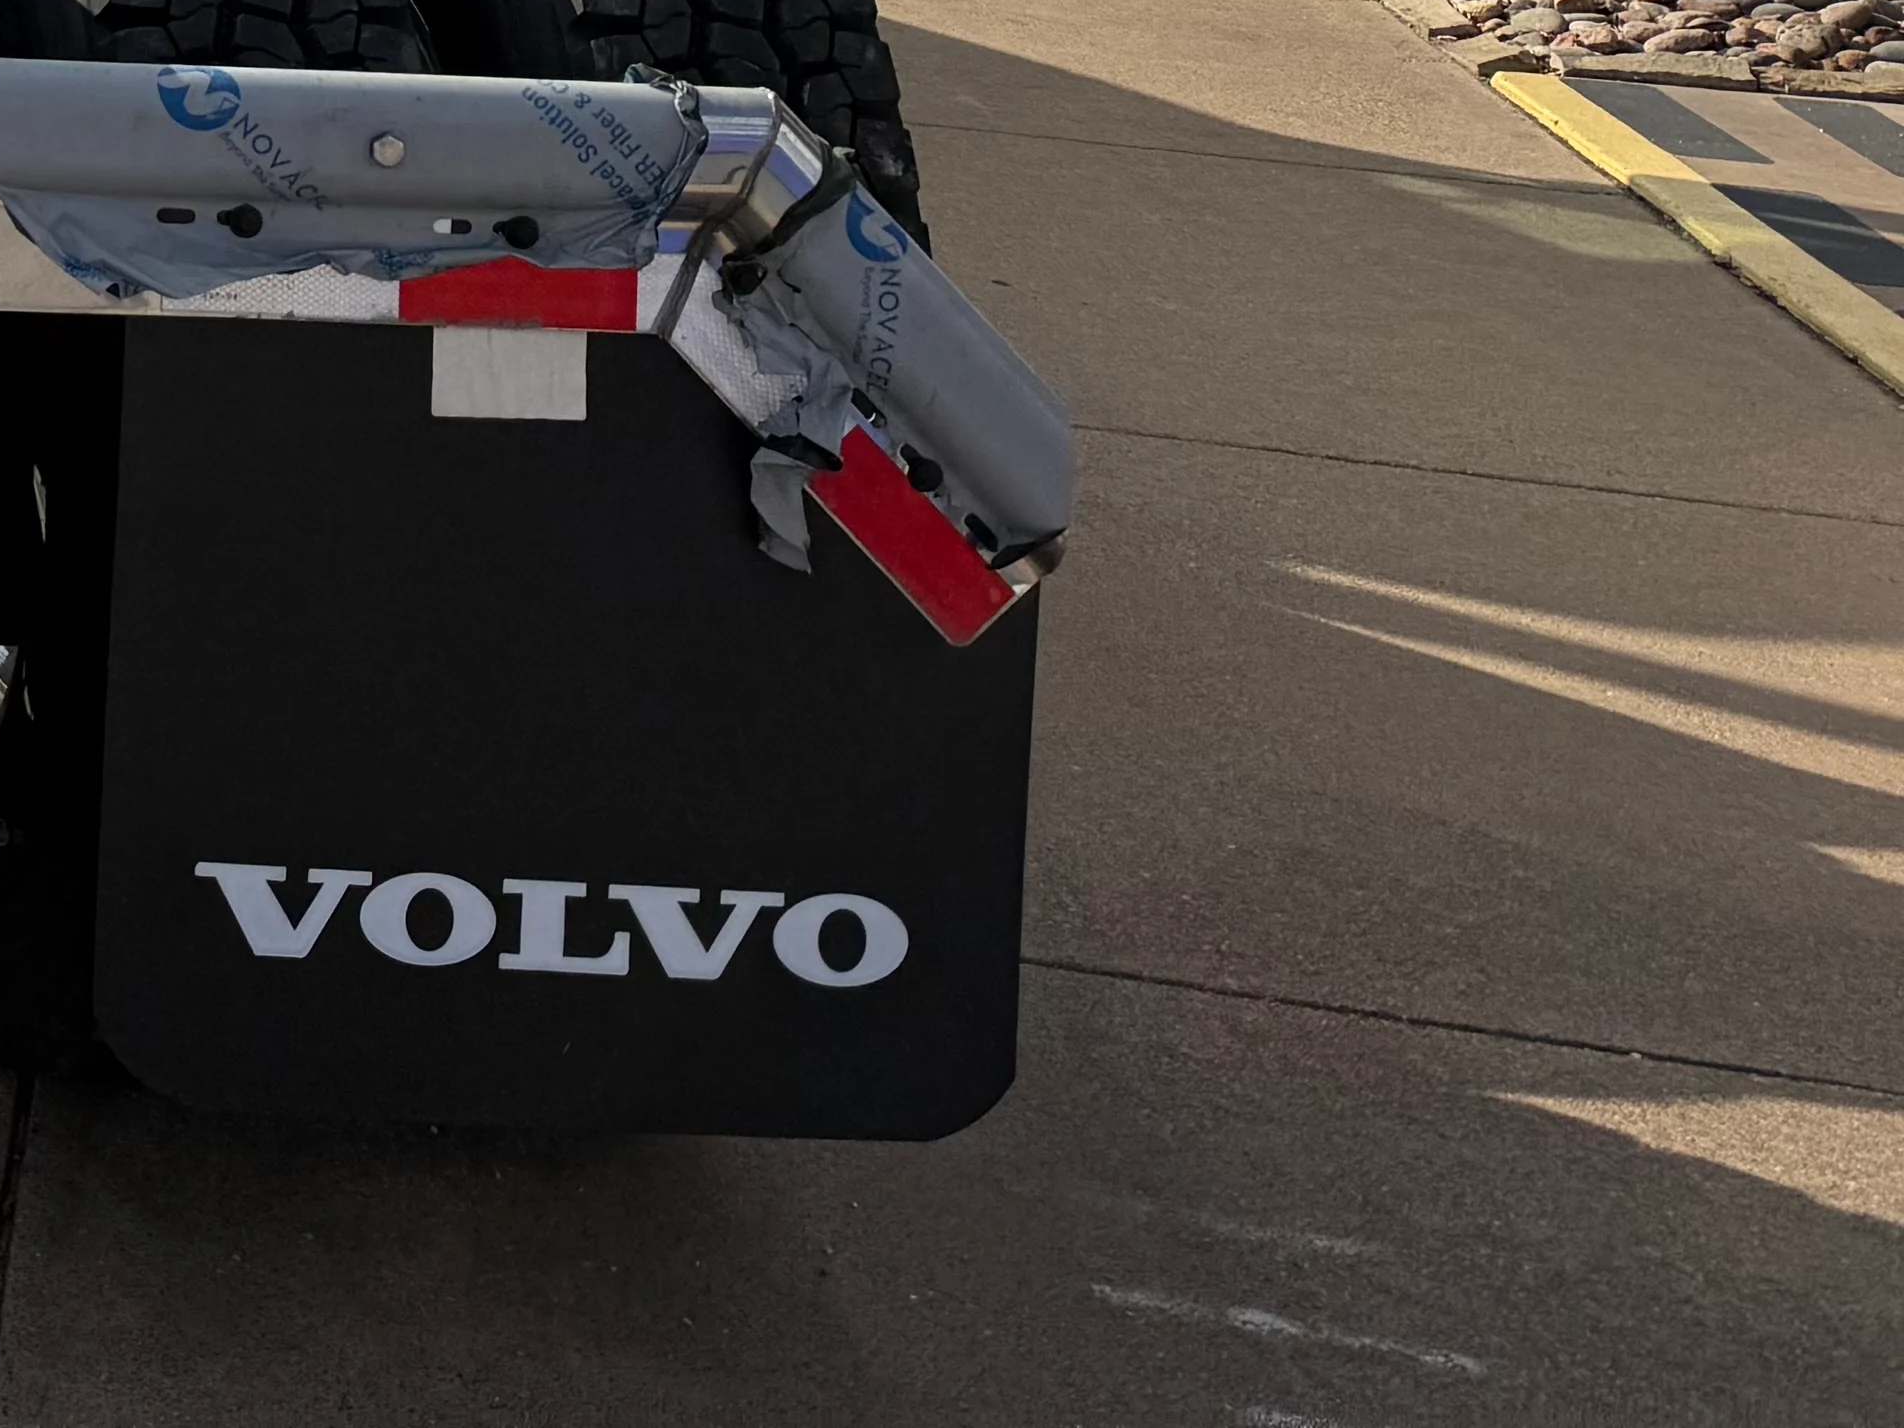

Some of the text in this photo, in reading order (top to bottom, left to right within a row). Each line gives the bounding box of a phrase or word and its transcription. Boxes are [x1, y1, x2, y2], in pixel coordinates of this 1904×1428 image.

[521, 86, 598, 164] Solution
[574, 91, 592, 110] &
[592, 106, 641, 160] Fiber
[866, 267, 902, 393] NOVACEL
[194, 861, 909, 988] VOLVO
